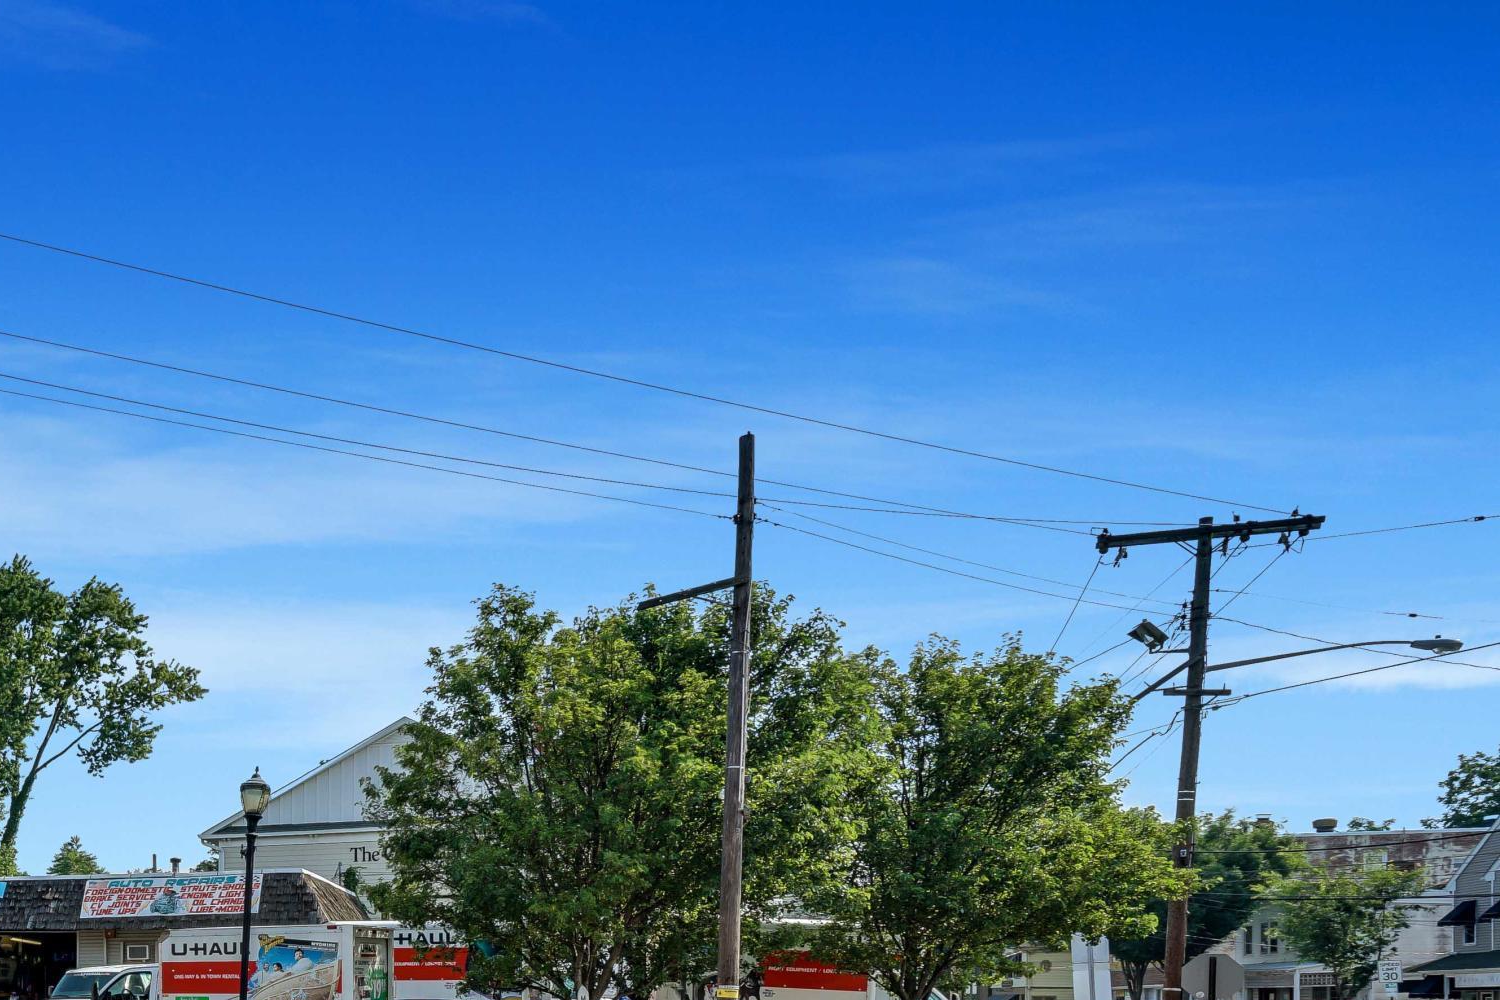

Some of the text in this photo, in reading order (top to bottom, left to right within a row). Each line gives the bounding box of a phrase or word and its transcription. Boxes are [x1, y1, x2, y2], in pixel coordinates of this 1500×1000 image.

[349, 846, 380, 862] The
[108, 876, 238, 888] AUTO REPAIRS
[117, 893, 157, 901] SERVICE
[180, 890, 248, 899] ENGINE LIGHT
[108, 900, 143, 908] JOINTS
[210, 898, 245, 906] CHANG
[118, 907, 138, 915] UPS
[1383, 972, 1398, 980] 30
